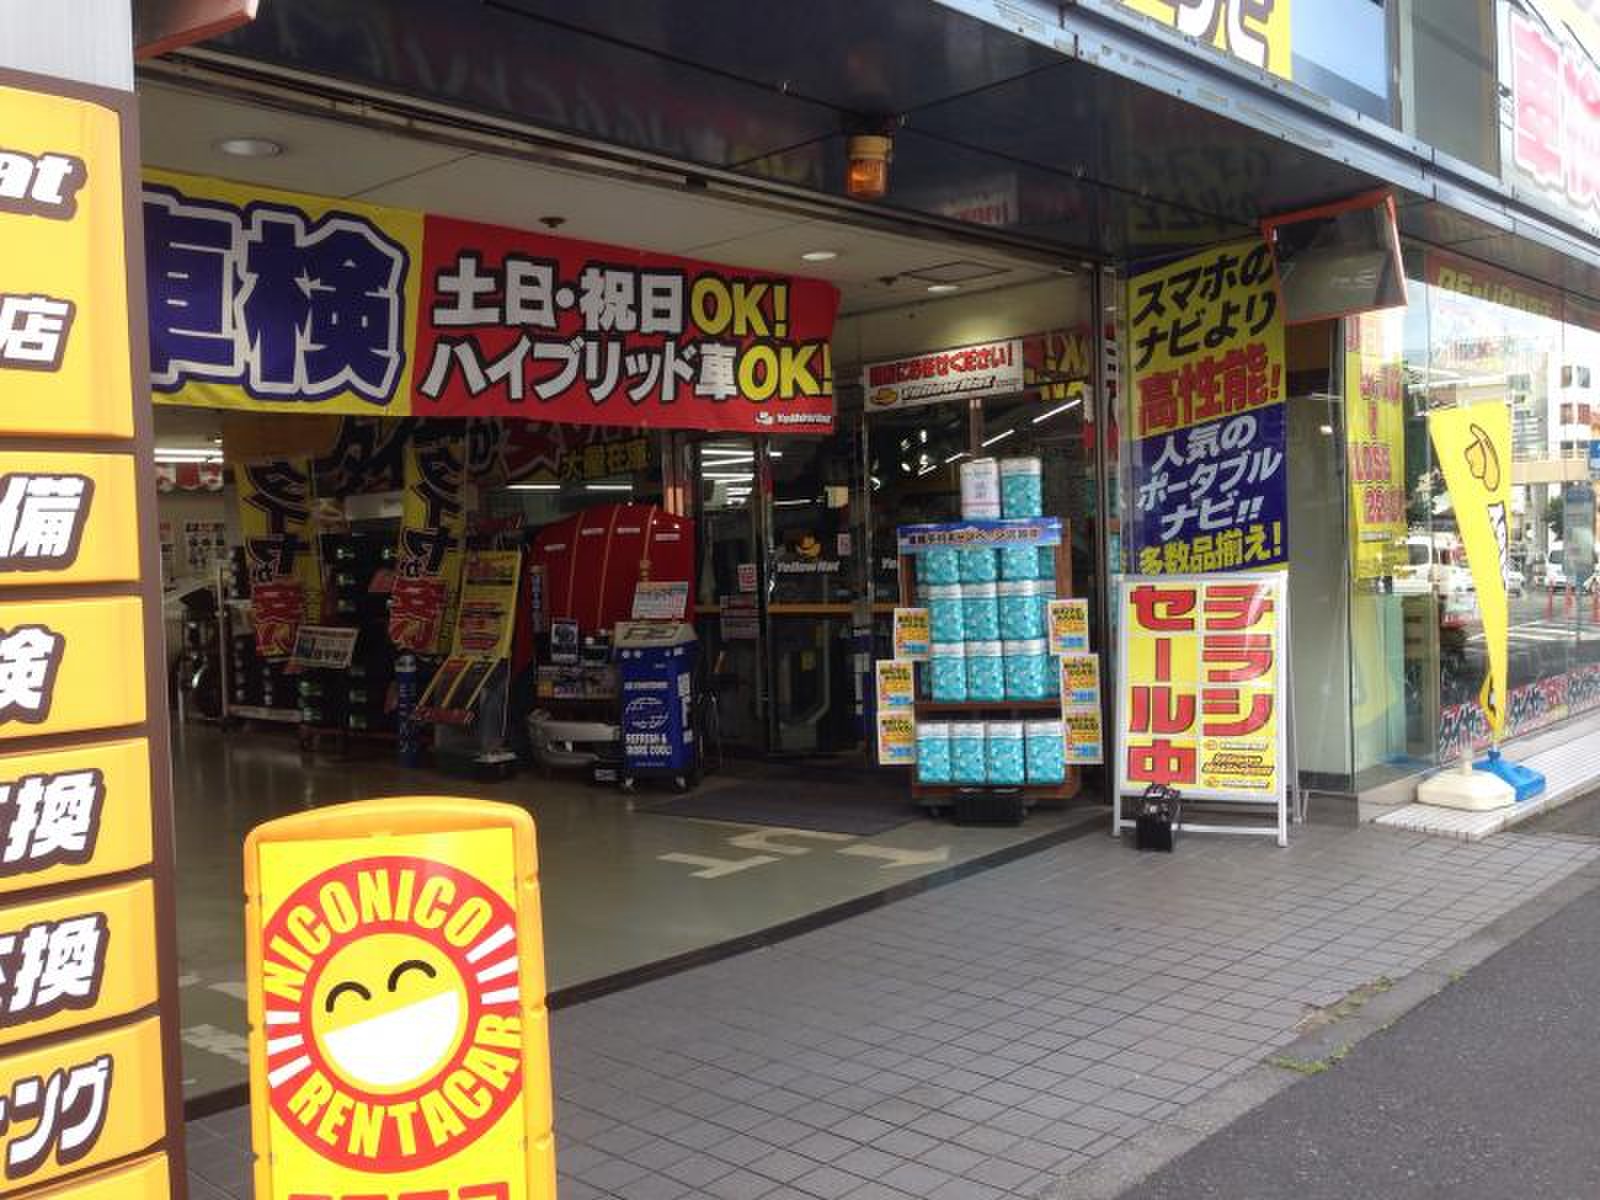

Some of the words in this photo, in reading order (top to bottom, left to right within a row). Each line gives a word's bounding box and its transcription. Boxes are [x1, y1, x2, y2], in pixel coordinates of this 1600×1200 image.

[1132, 246, 1275, 328] スマホの
[0, 297, 68, 364] 店
[420, 336, 832, 401] ハイブリッド車OK!
[1135, 291, 1277, 372] ナビより
[1138, 343, 1281, 436] 高性能!
[1137, 447, 1282, 511] ポータブル
[1152, 415, 1257, 473] 人気の
[1139, 521, 1281, 576] 多数品揃え!
[1161, 490, 1265, 541] ナビ!!
[1127, 584, 1198, 785] セール中
[1202, 583, 1274, 736] チラシ
[0, 772, 97, 863] 換
[0, 915, 100, 1013] 換
[264, 868, 493, 1003] NICONICO
[0, 1058, 110, 1164] ング
[287, 1012, 522, 1159] RENTACAR
